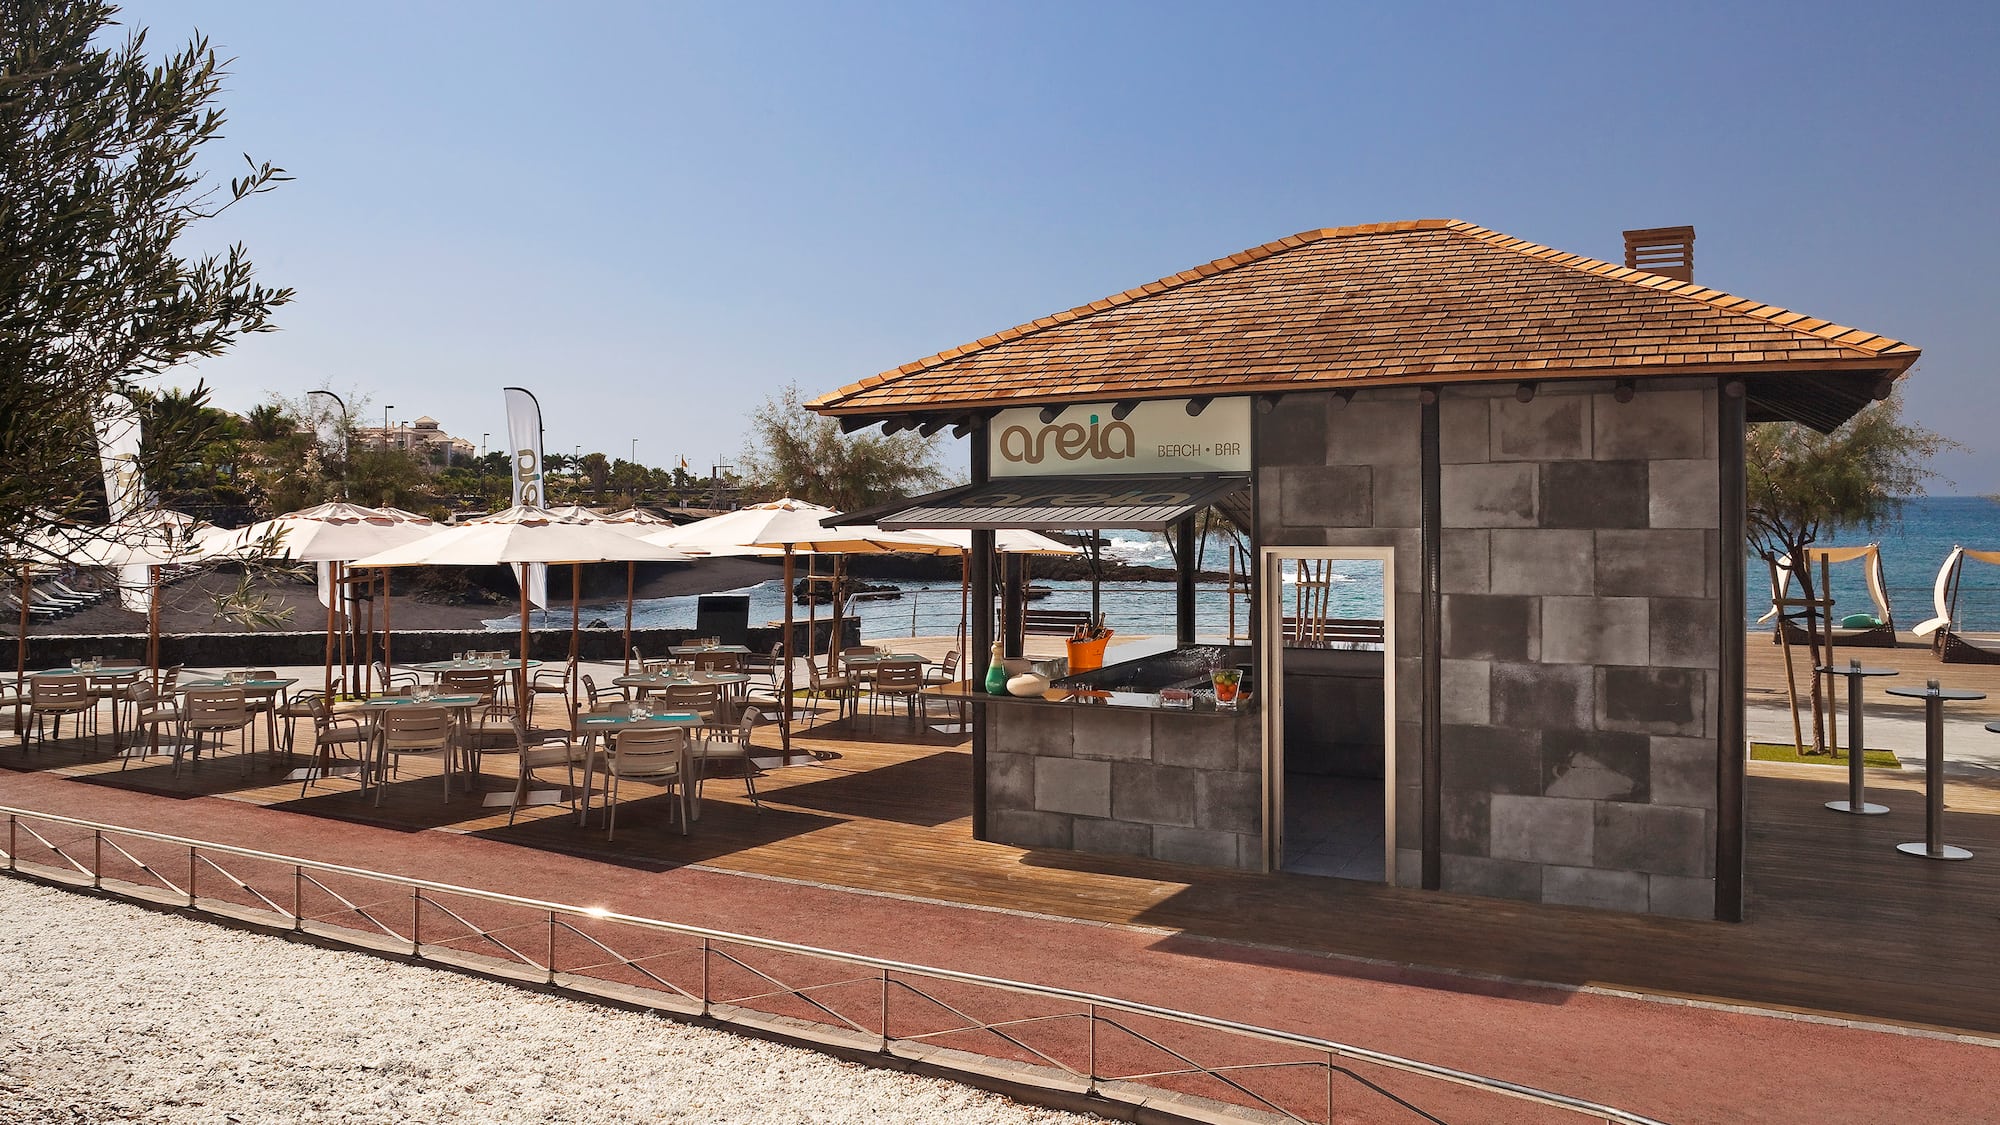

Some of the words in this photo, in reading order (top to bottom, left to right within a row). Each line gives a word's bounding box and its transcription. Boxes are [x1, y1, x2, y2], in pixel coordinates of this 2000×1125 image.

[1000, 414, 1135, 464] areia
[1158, 444, 1201, 458] BEACH
[1215, 443, 1240, 456] BAR
